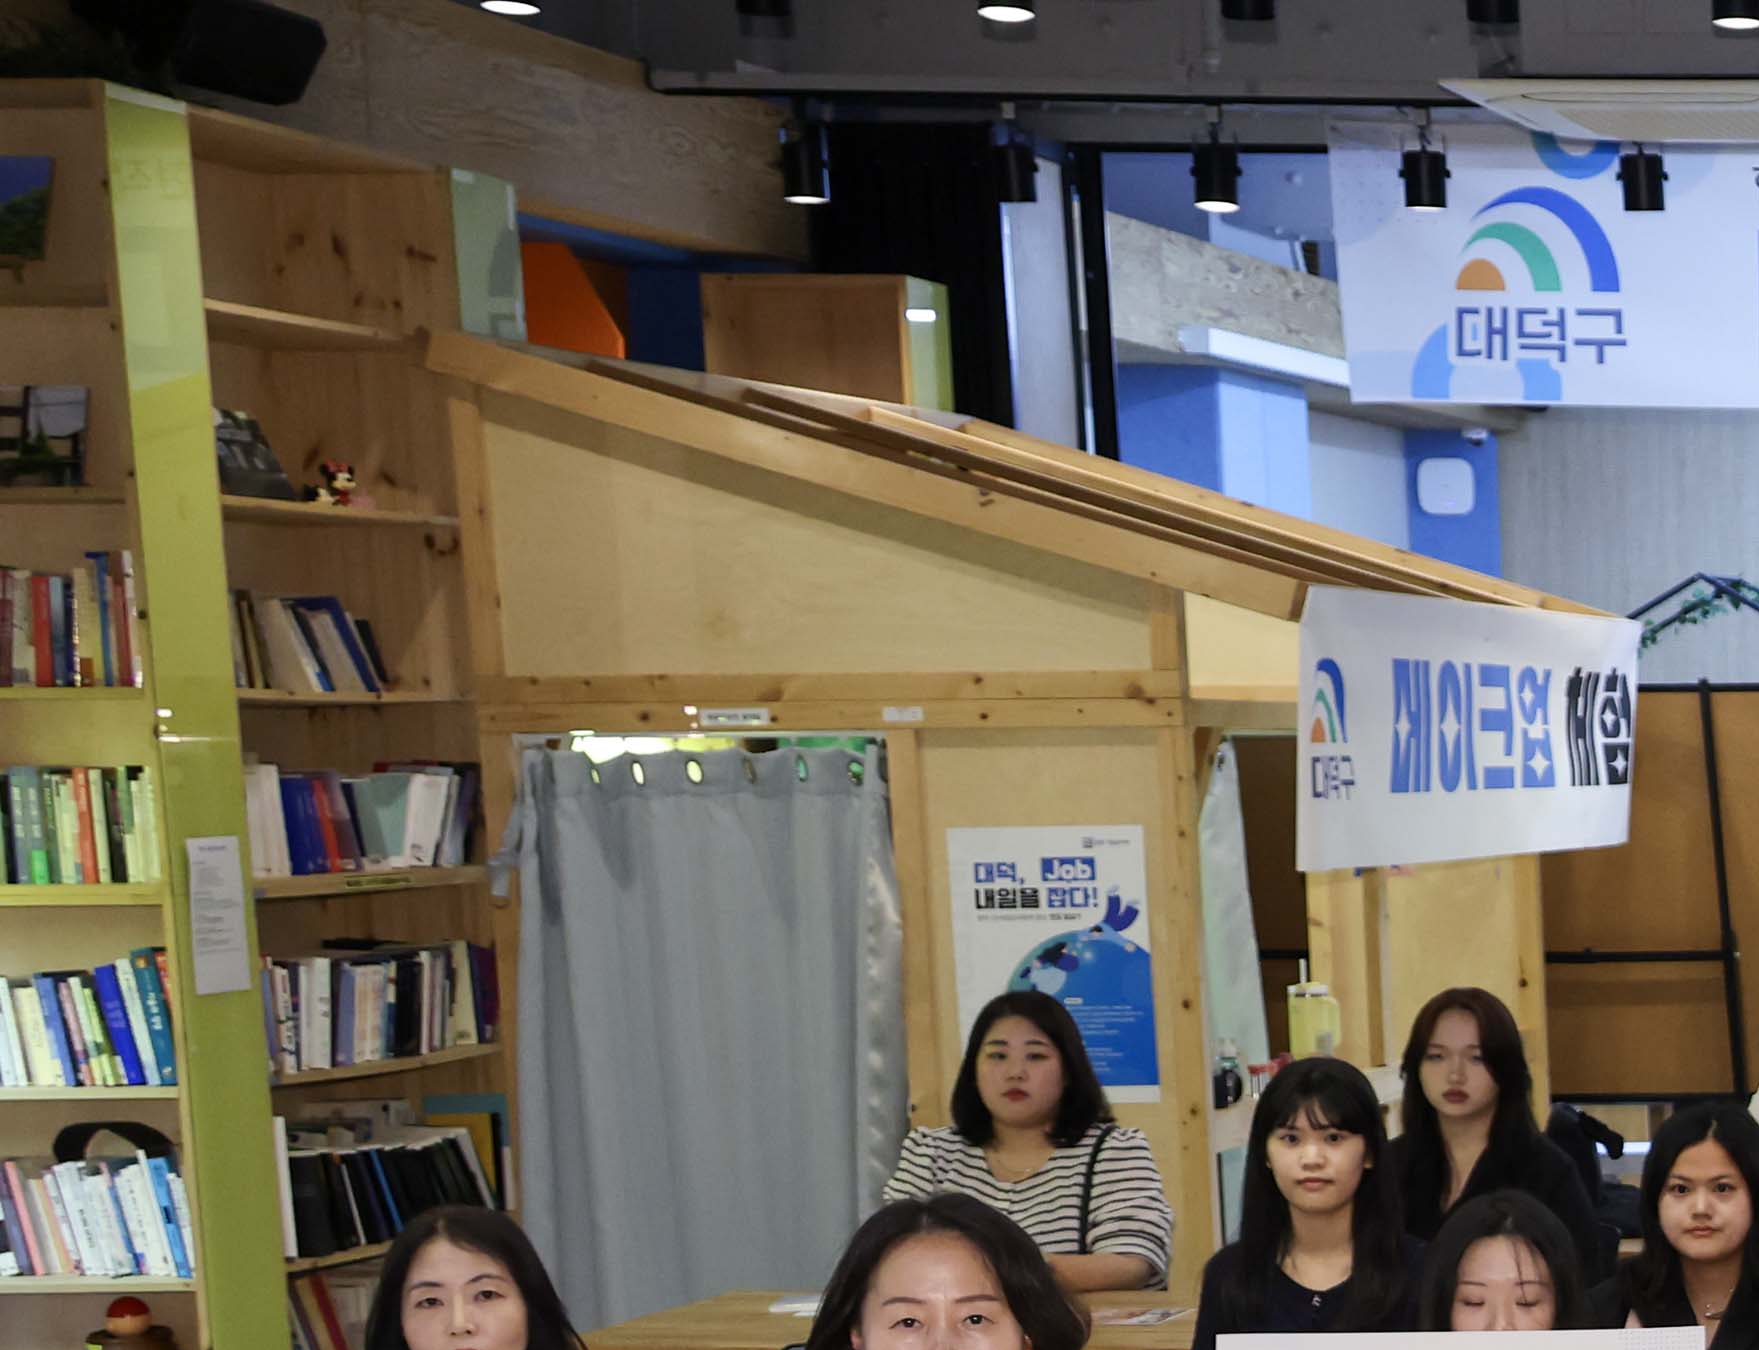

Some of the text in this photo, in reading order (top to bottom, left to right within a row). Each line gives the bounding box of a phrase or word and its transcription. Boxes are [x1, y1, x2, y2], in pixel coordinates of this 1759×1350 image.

[1455, 307, 1627, 364] 대덕구
[1390, 658, 1556, 794] 메이크업
[1312, 756, 1355, 800] 대덕구
[1044, 859, 1092, 881] Job
[976, 887, 1098, 909] 내일을 잡다!
